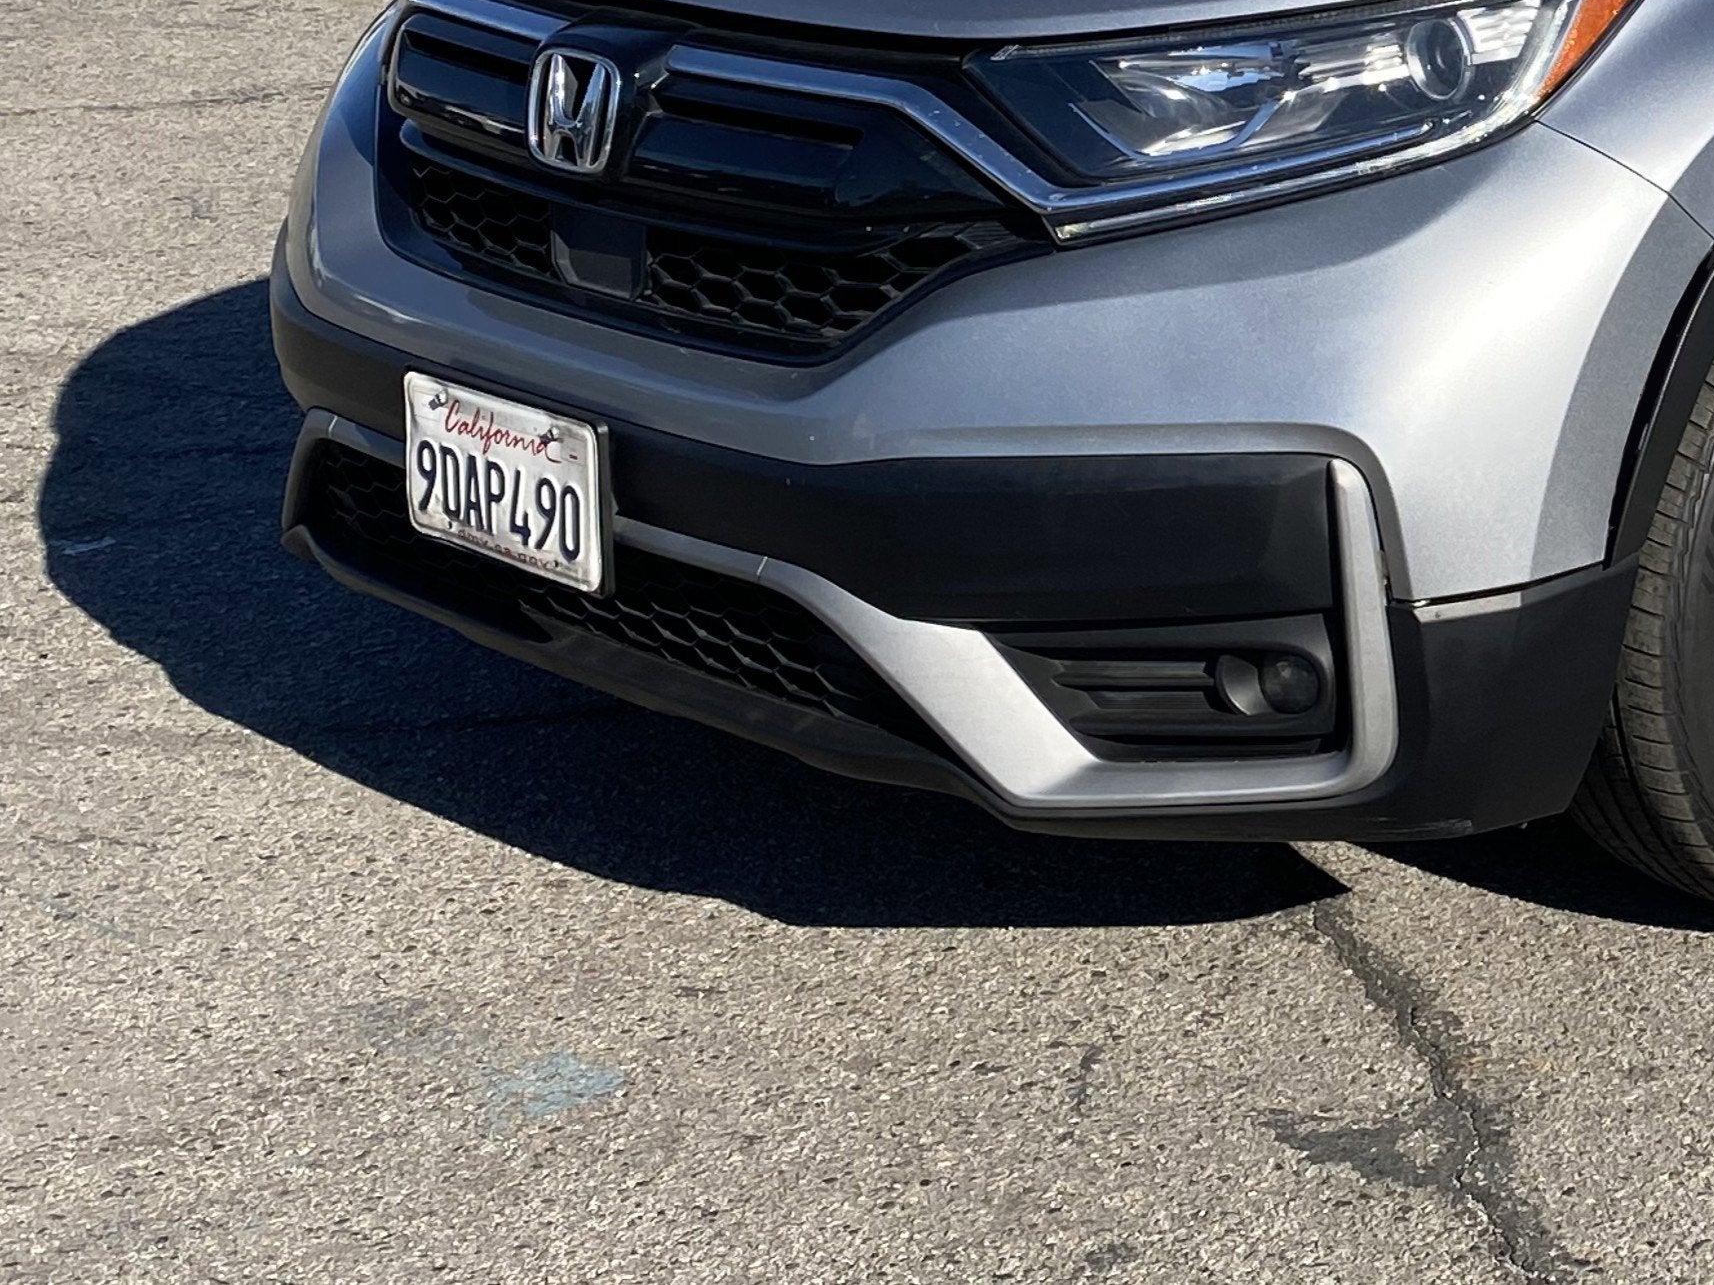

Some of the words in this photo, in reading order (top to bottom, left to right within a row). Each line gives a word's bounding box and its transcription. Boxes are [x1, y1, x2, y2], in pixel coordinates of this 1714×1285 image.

[444, 399, 562, 464] California
[417, 439, 580, 563] 9DAP490
[457, 529, 551, 570] dmv.ca.gov
